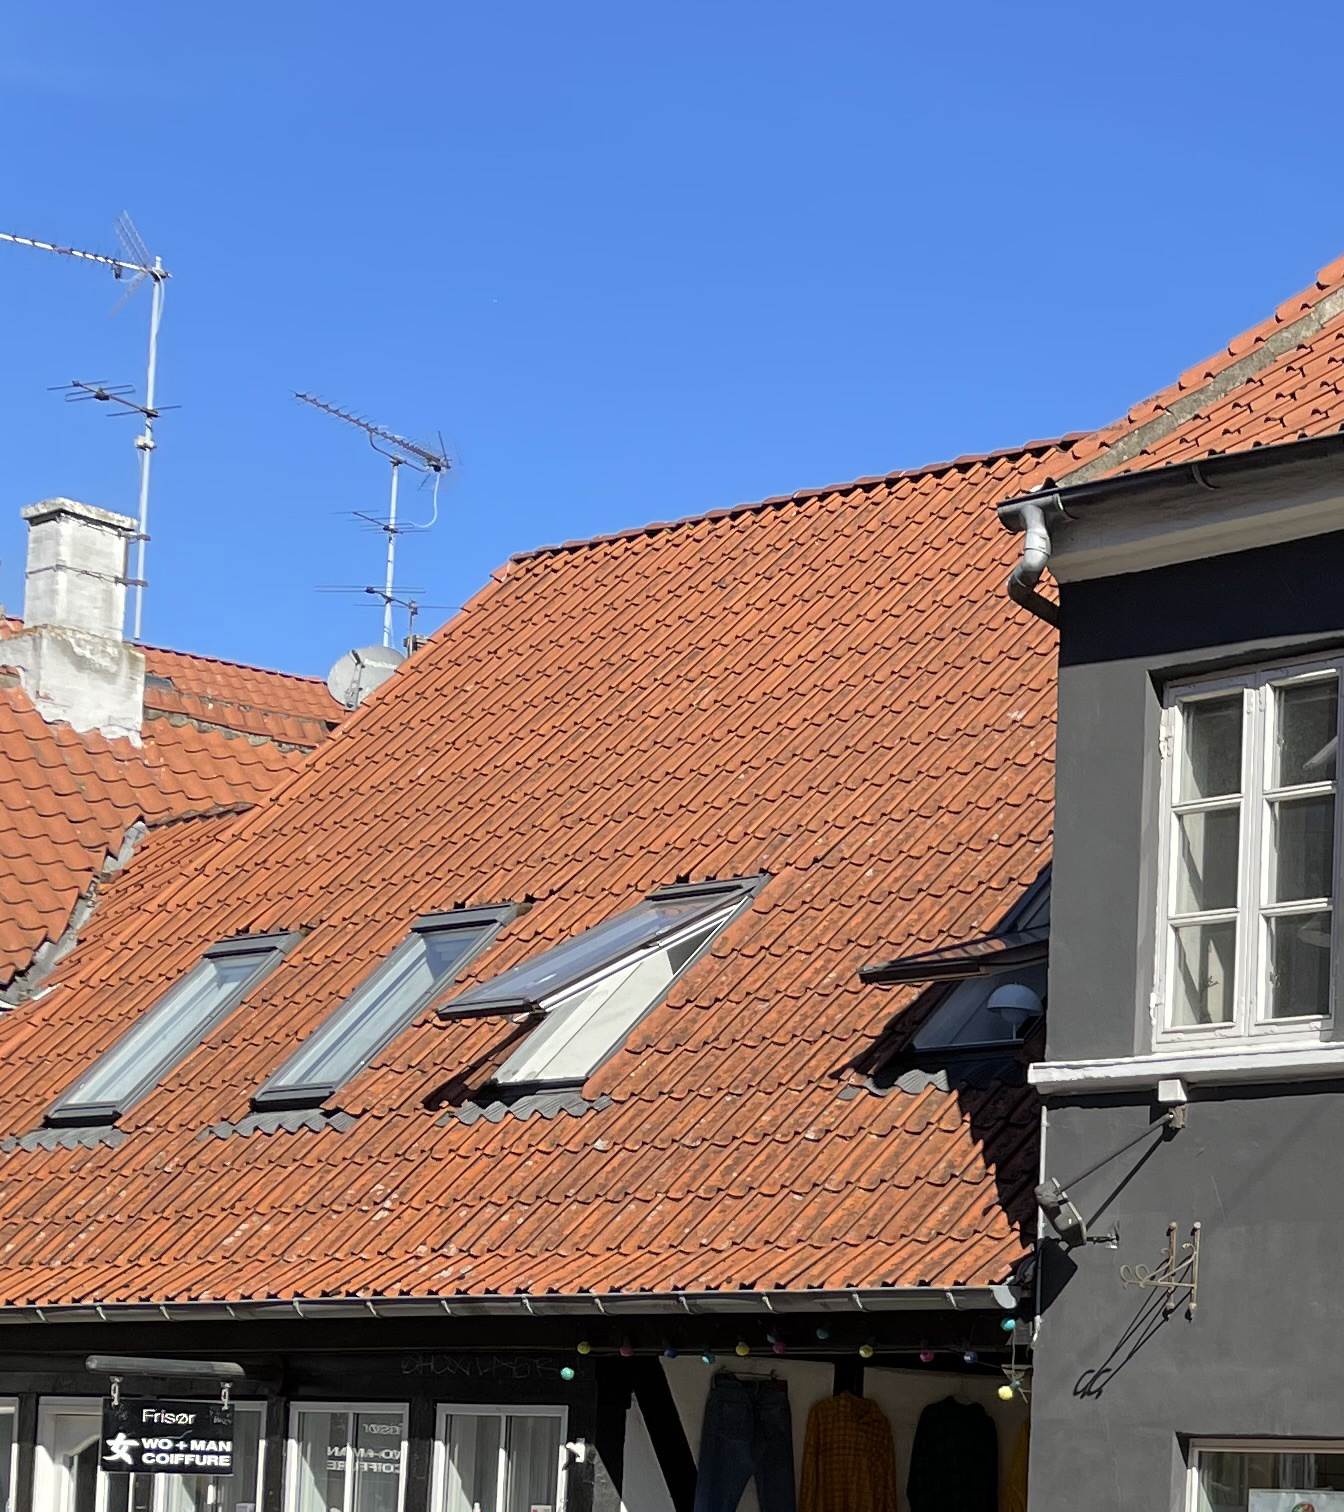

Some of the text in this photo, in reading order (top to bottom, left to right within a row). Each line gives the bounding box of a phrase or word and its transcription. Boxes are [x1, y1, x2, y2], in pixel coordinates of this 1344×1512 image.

[142, 1408, 197, 1425] Frisør
[141, 1437, 173, 1450] WO
[190, 1440, 232, 1452] MAN
[141, 1453, 231, 1467] COIFFURE
